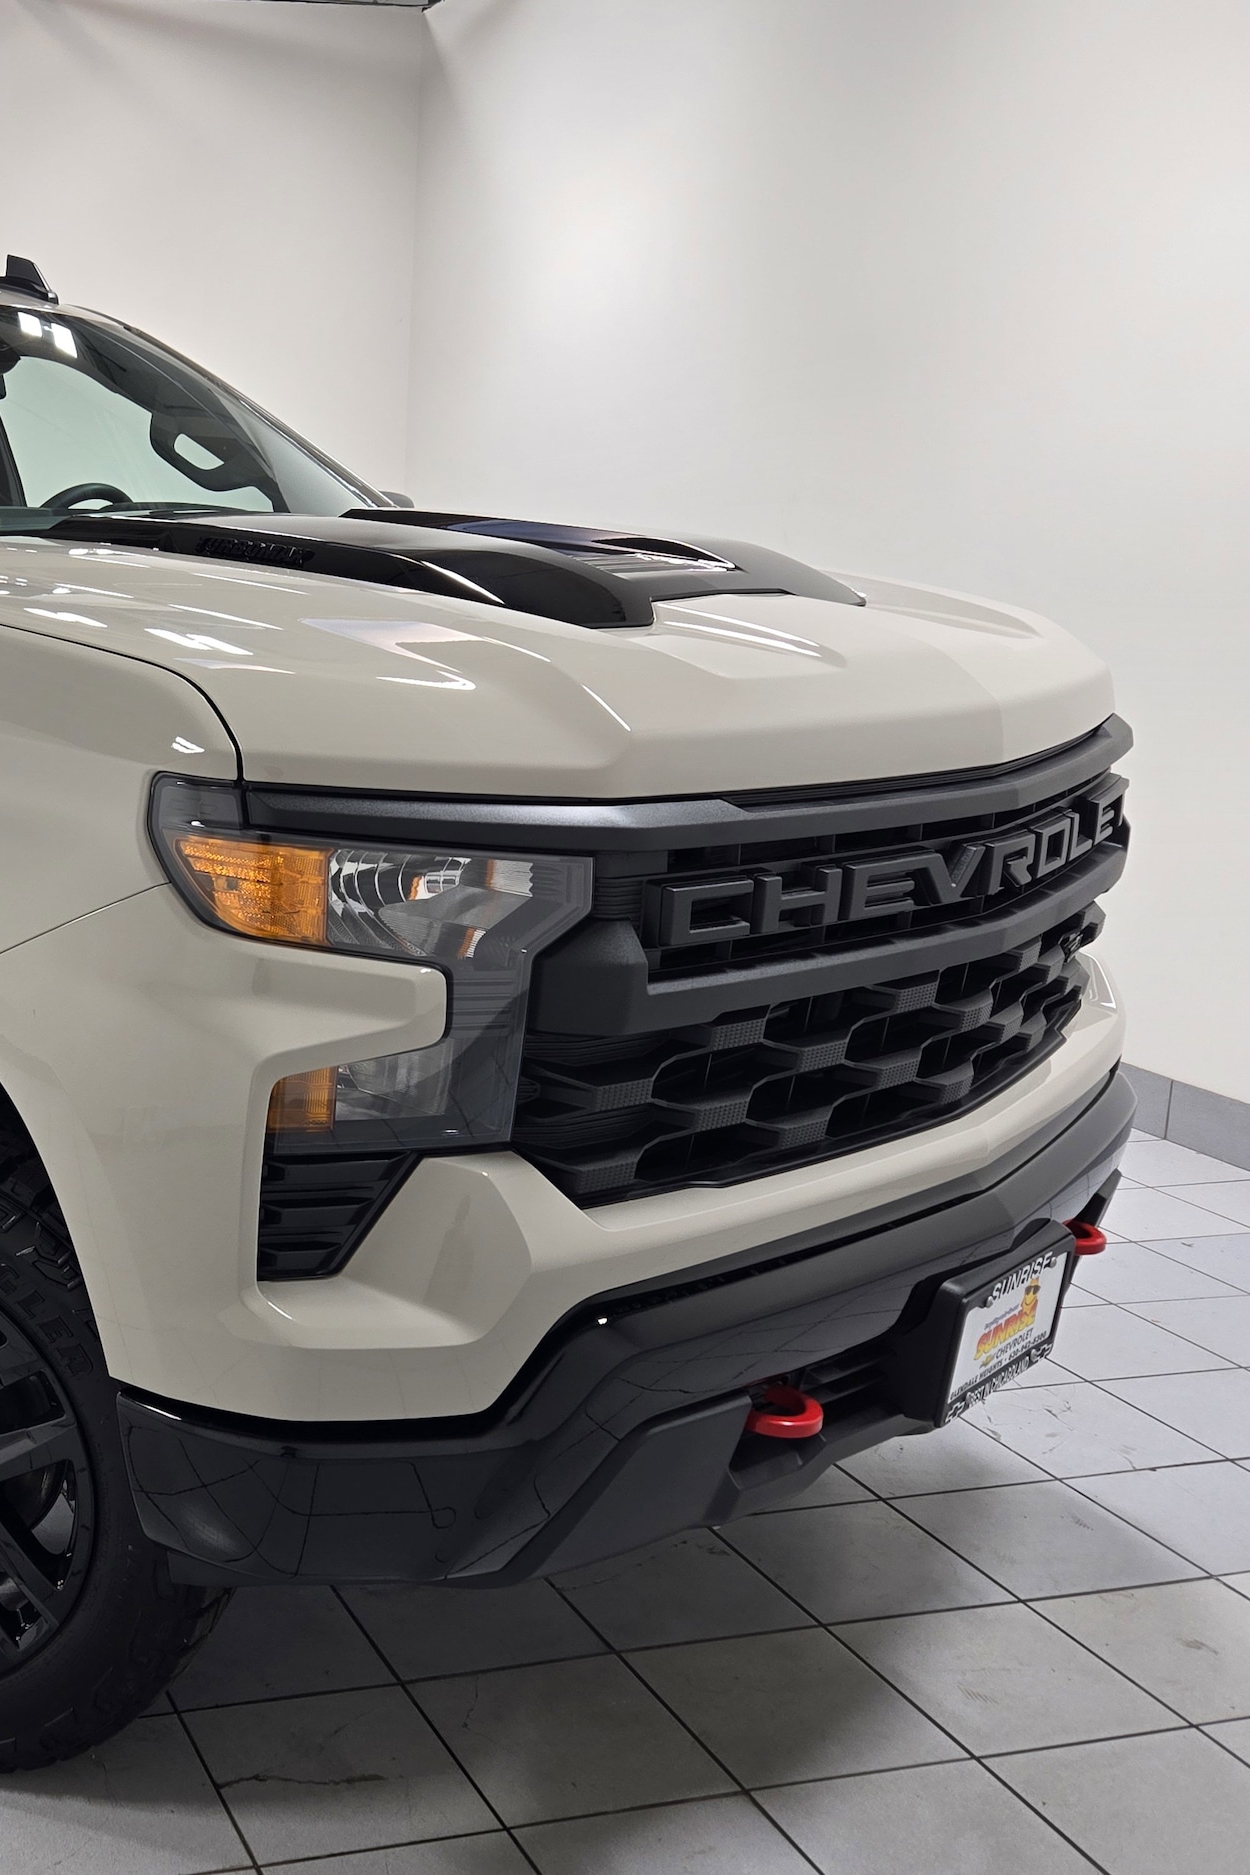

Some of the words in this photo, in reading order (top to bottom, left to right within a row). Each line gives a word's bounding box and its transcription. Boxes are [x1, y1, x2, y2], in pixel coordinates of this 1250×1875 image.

[991, 1251, 1053, 1302] SUNRISE
[973, 1308, 1036, 1361] SUNRISE
[995, 1327, 1034, 1360] CHEVROLET
